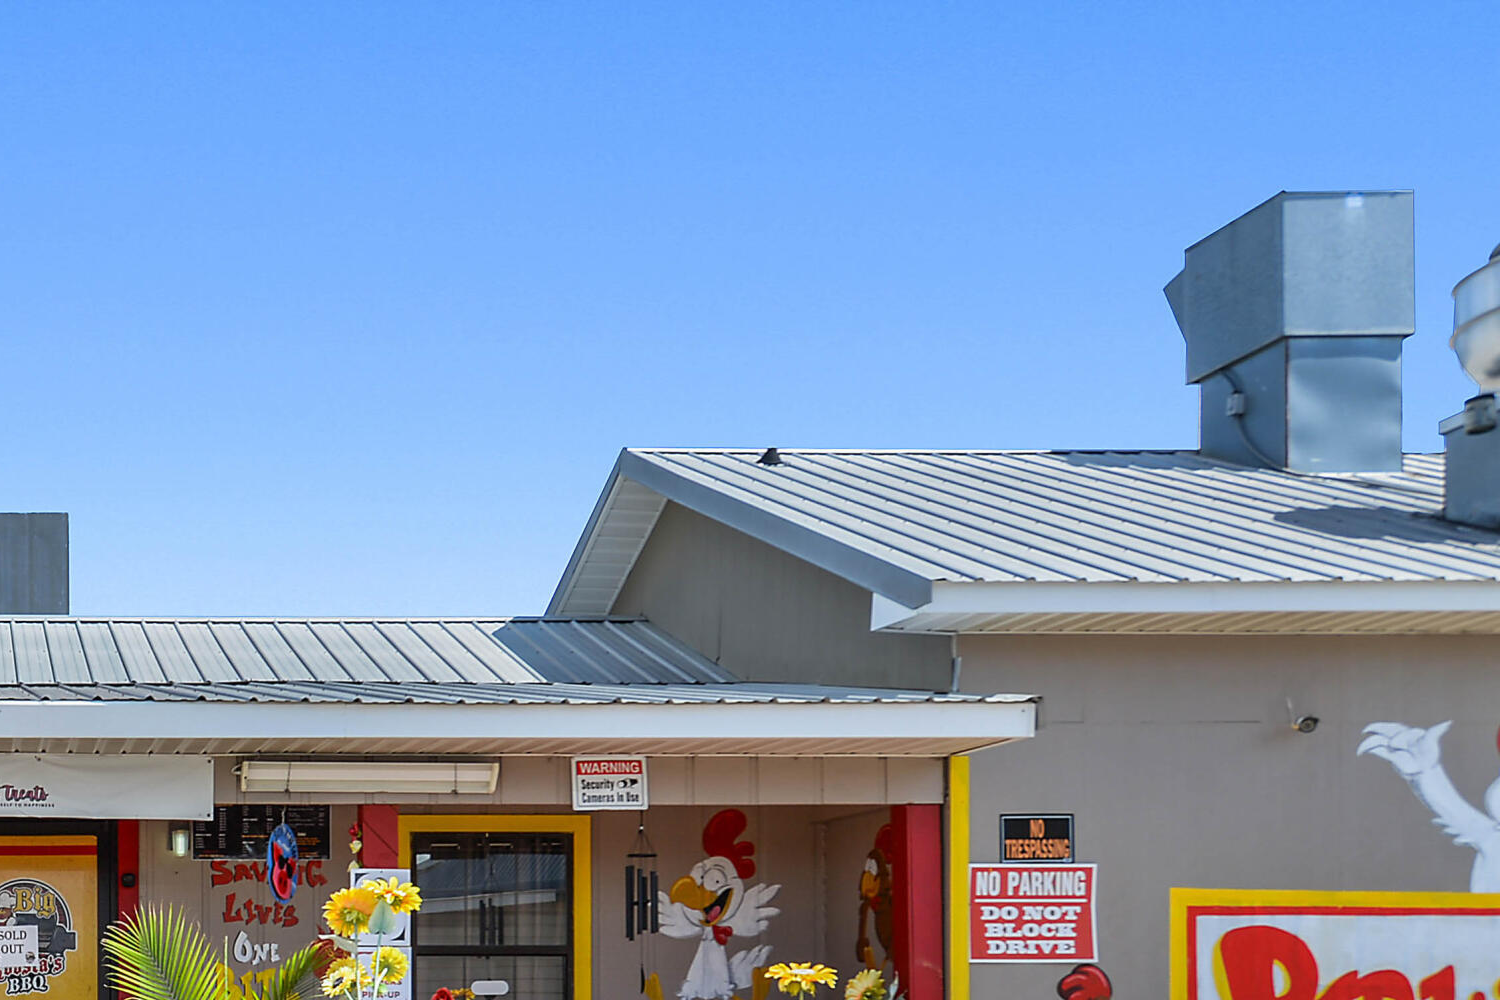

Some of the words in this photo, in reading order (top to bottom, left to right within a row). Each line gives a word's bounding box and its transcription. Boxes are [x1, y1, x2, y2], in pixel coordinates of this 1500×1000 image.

[580, 762, 640, 774] WARNING
[581, 779, 615, 791] Security
[2, 785, 49, 801] Treats
[582, 793, 615, 803] Cameras
[1030, 819, 1045, 838] NO
[1005, 838, 1070, 859] TRESPASSING
[210, 860, 328, 887] SAVG
[975, 871, 1001, 896] NO
[1007, 870, 1086, 897] PARKING
[14, 887, 57, 918] Big
[980, 906, 1019, 920] DO
[1022, 906, 1082, 920] NOT
[984, 923, 1077, 938] BLOCK
[1, 944, 25, 954] OUT
[986, 940, 1077, 955] DRIVE
[6, 975, 49, 995] BBQ
